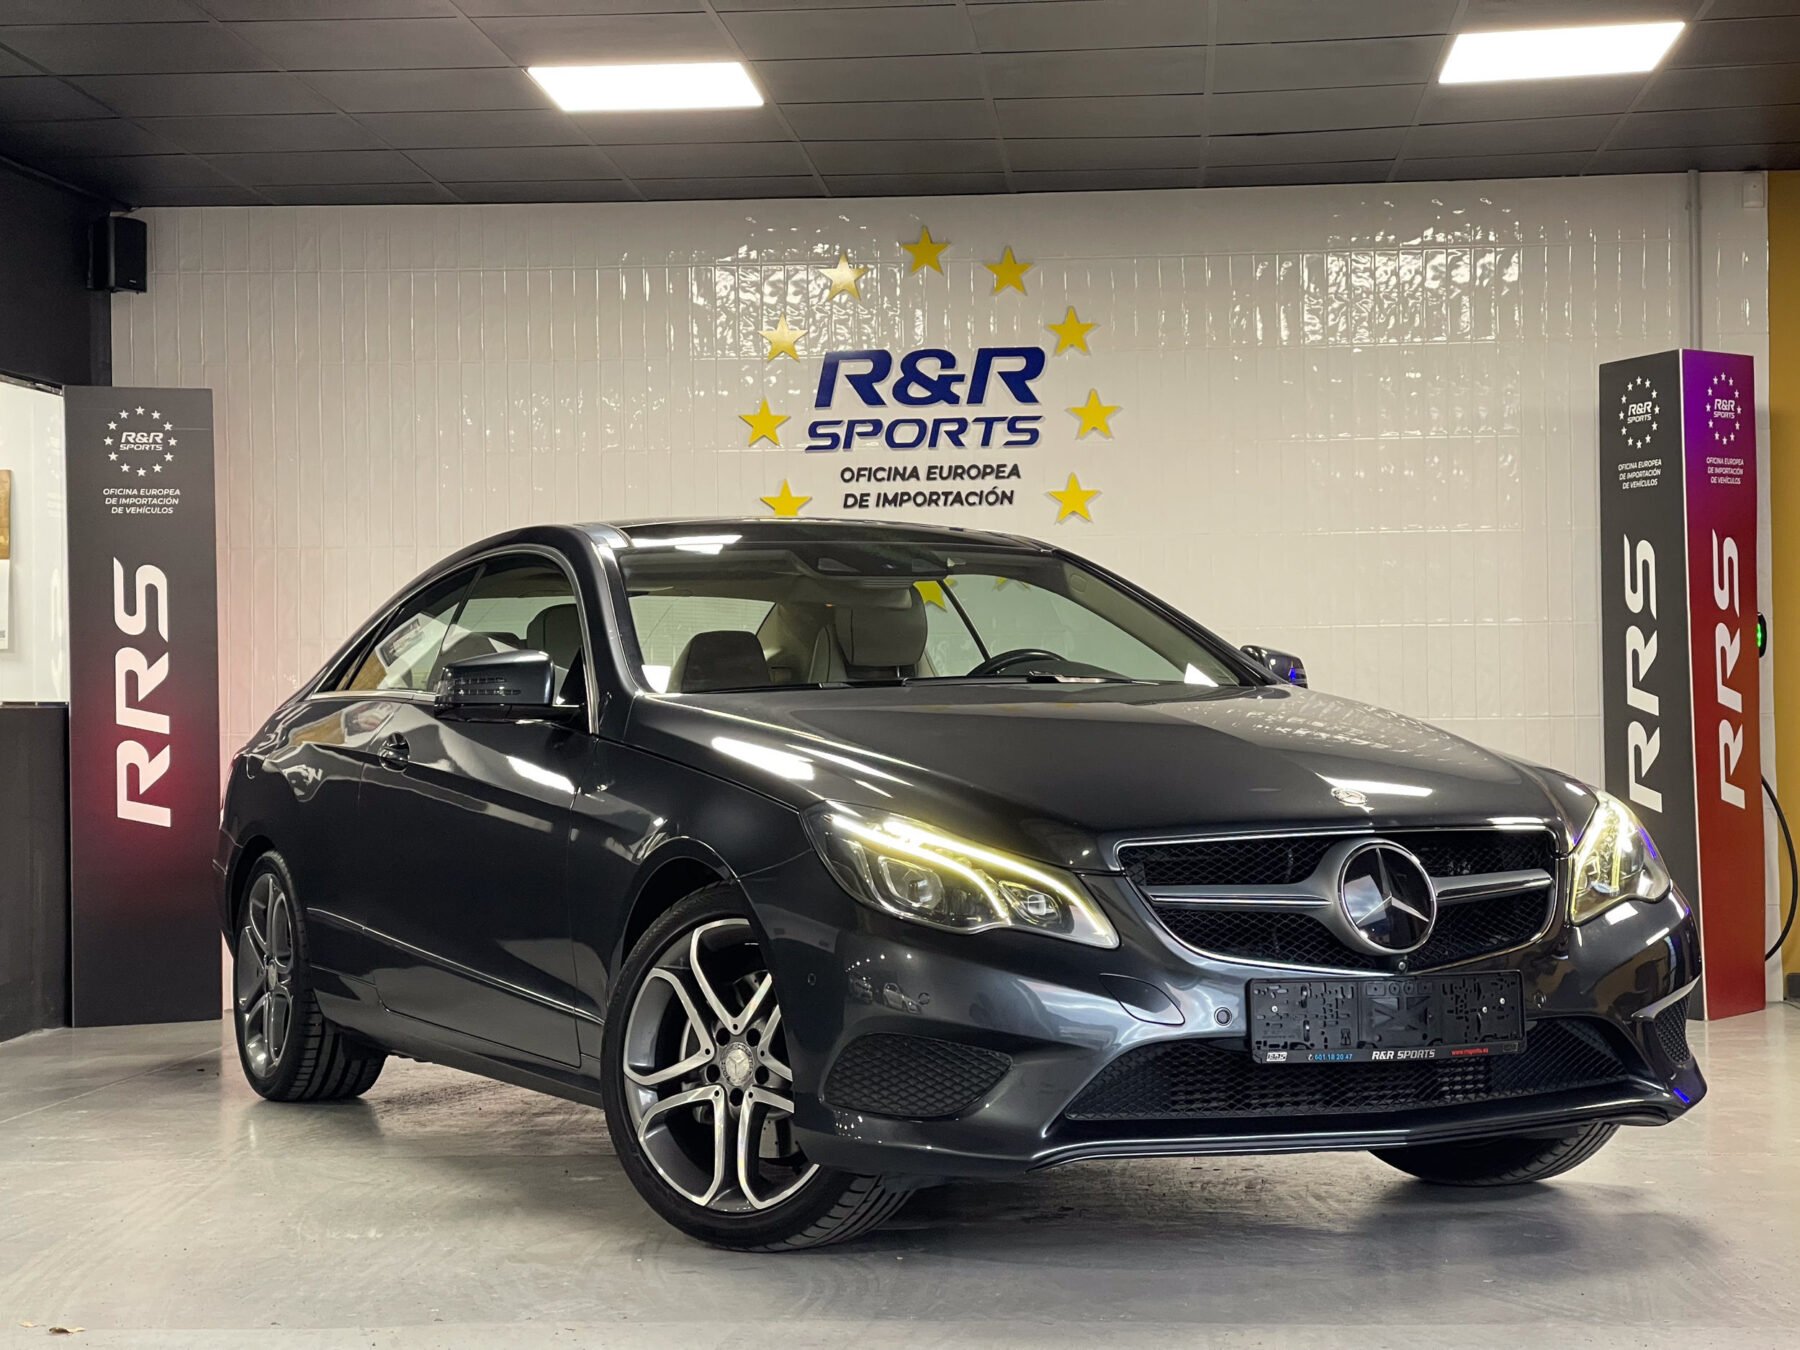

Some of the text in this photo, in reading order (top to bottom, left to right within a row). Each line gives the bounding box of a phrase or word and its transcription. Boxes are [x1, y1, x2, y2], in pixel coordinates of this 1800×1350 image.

[814, 346, 1046, 408] R&R
[1628, 401, 1652, 416] R&R
[1714, 398, 1735, 411] R&R
[1627, 414, 1652, 424] SPORTS
[1713, 411, 1735, 419] SPORTS
[121, 432, 164, 443] R&R
[804, 415, 1044, 452] SPORTS
[119, 443, 163, 451] SPORTS
[1618, 458, 1662, 471] OFICINA EUROPEA
[1706, 457, 1744, 465] OFICINA EUROPEA
[840, 463, 1021, 483] OFICINA EUROPEA
[1626, 468, 1661, 480] IMPORTACIÓN
[1630, 478, 1658, 488] VEHÍCULOS
[140, 488, 181, 496] EUROPEA
[843, 486, 1014, 509] DE IMPORTACIÓN
[119, 497, 179, 505] IMPORTACIÓN
[125, 506, 174, 514] VEHÍCULOS
[1624, 533, 1663, 813] RRS
[1712, 528, 1745, 810] RRS
[113, 557, 171, 828] RRS
[1372, 1049, 1436, 1060] R&R SPORTS
